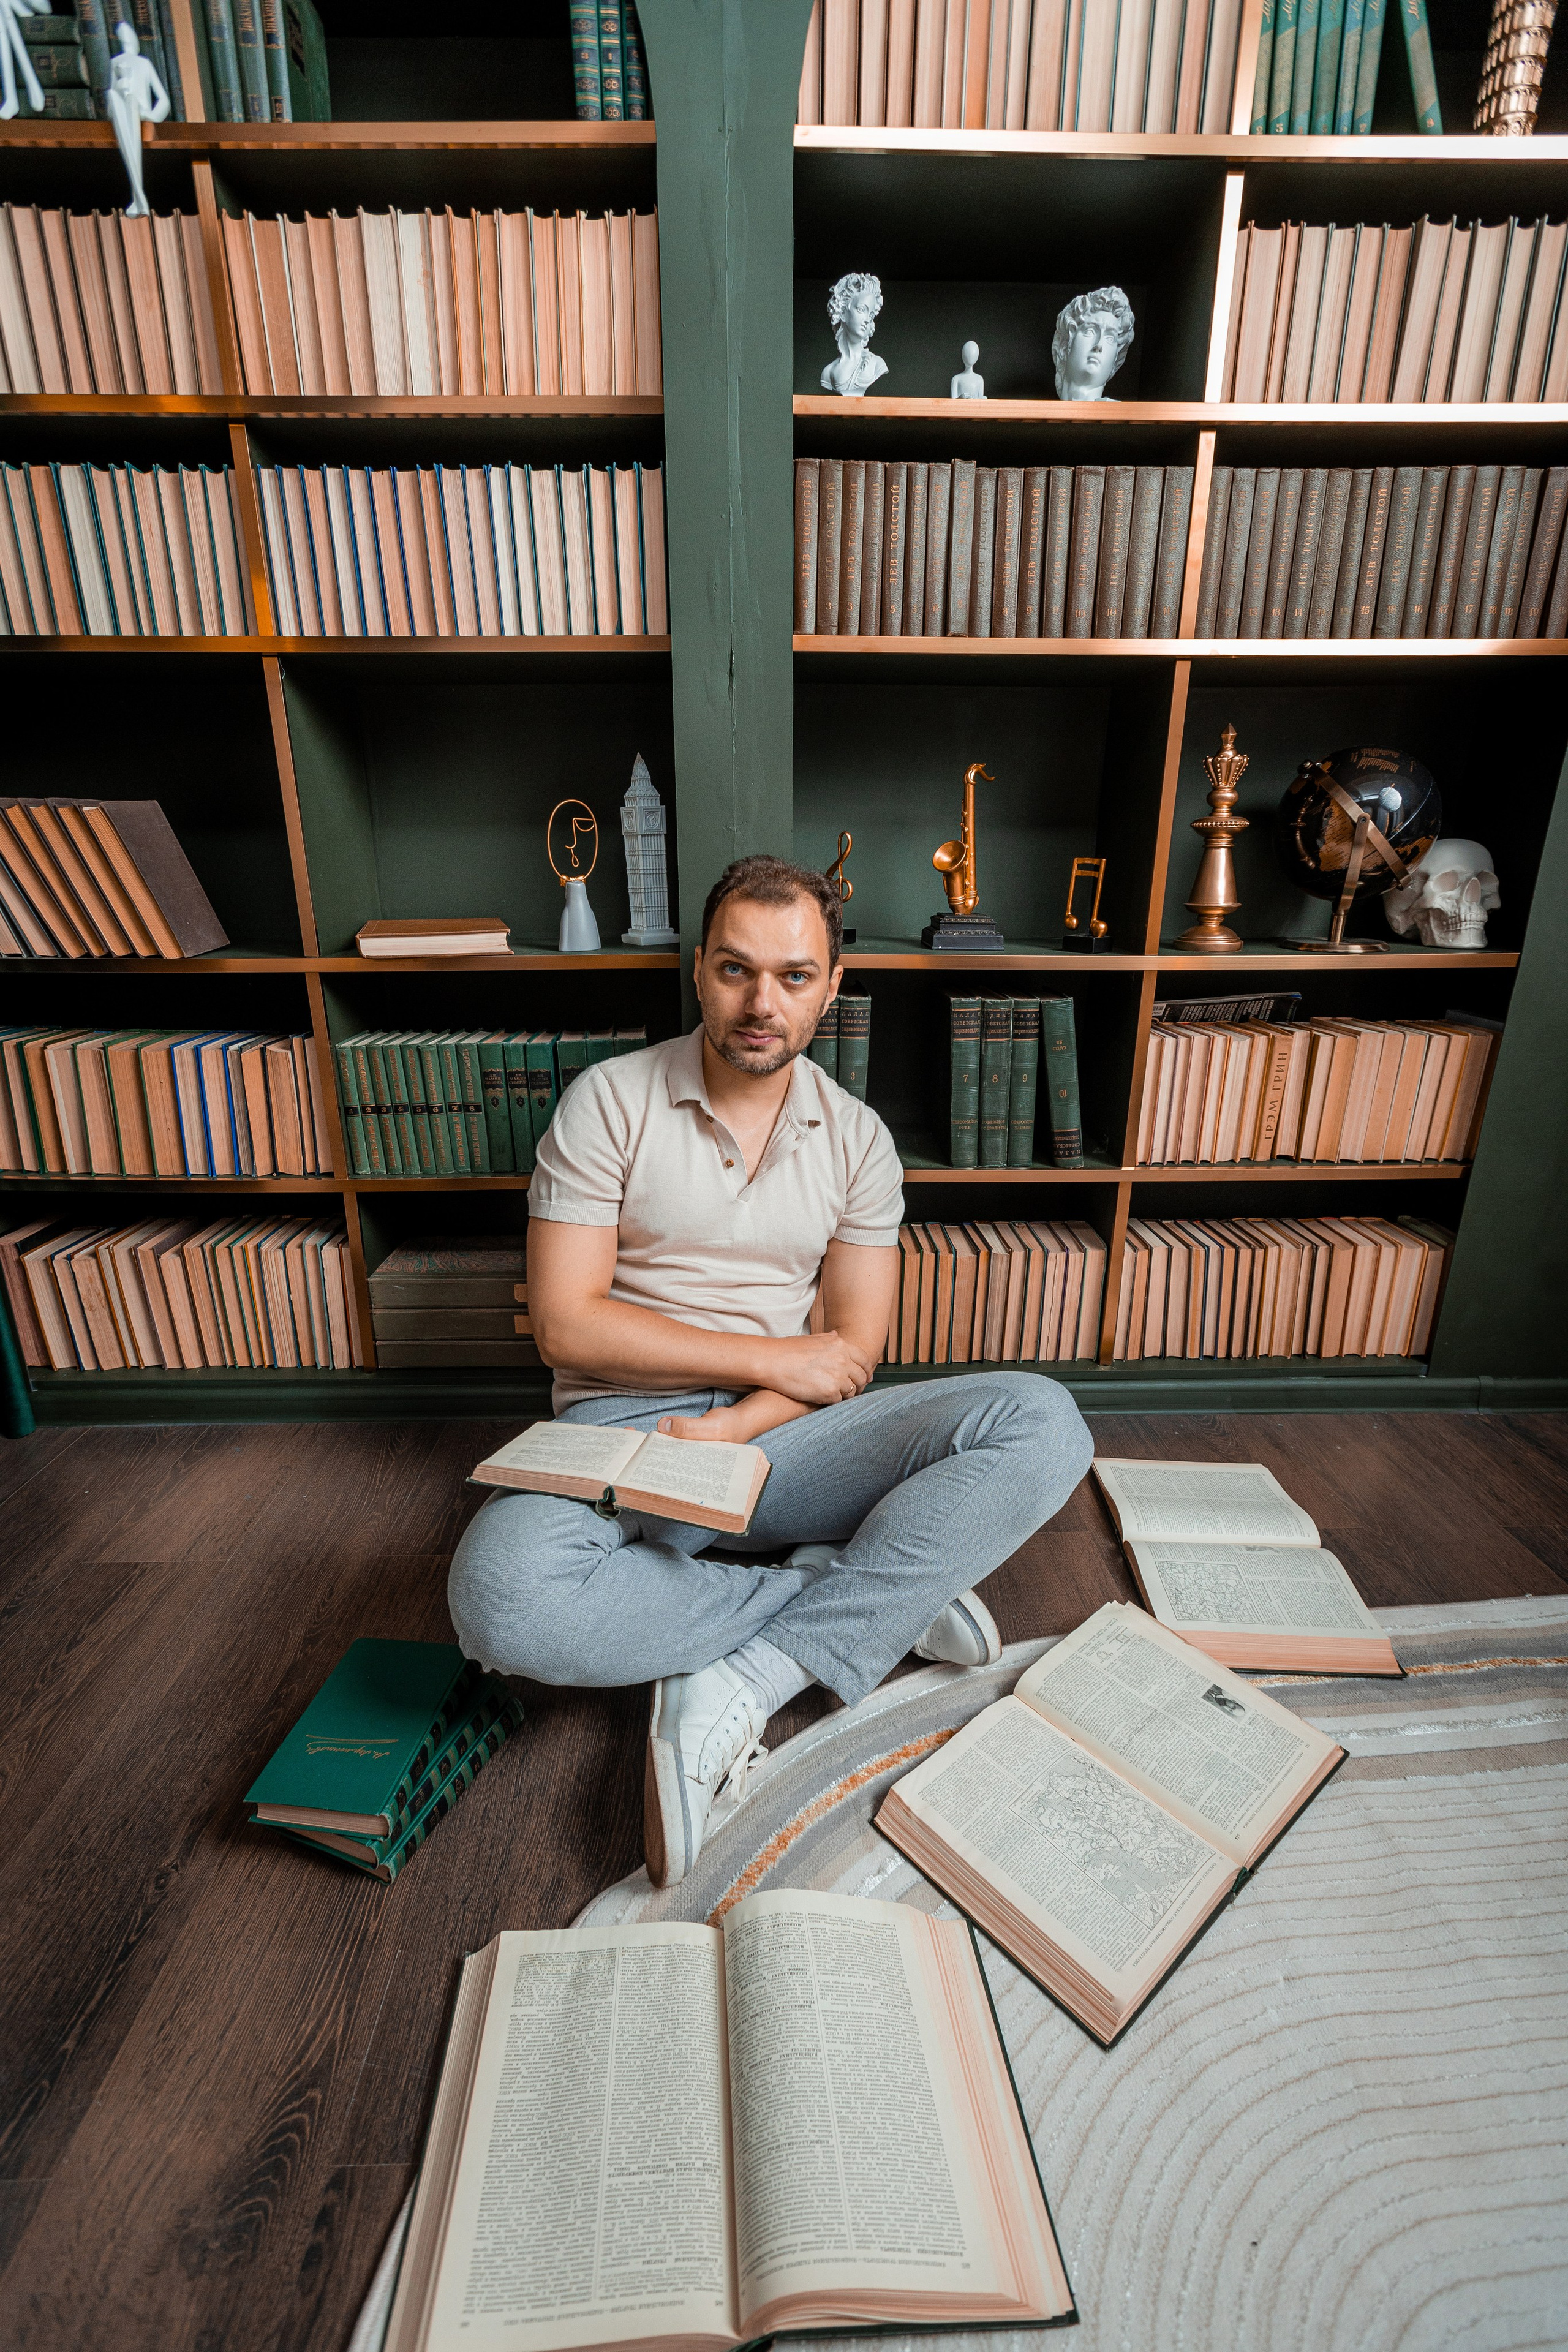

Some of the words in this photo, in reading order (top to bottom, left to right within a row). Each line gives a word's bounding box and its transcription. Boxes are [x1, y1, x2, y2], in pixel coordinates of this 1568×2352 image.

[803, 480, 812, 543] ТОЛСТОЙ
[826, 483, 835, 545] ТОЛСТОЙ
[848, 483, 858, 547] ТОЛСТОЙ
[891, 484, 900, 549] ТОЛСТОЙ
[1004, 489, 1014, 552] ТОЛСТОЙ
[1030, 489, 1041, 552] ТОЛСТОЙ
[1298, 563, 1308, 588] ЛЕВ
[1303, 491, 1318, 552] ТОЛСТОЙ
[1370, 489, 1387, 552] ТОЛСТОЙ
[826, 556, 834, 582] ЛЕВ
[889, 559, 898, 584] ЛЕВ
[1003, 562, 1011, 586] ЛЕВ
[1366, 561, 1376, 587] ЛЕВ
[802, 599, 808, 608] 2
[1295, 608, 1302, 616] 14
[1059, 1089, 1067, 1098] 10
[1265, 1100, 1278, 1139] ГРЭМ
[1272, 1052, 1287, 1090] ГРИН
